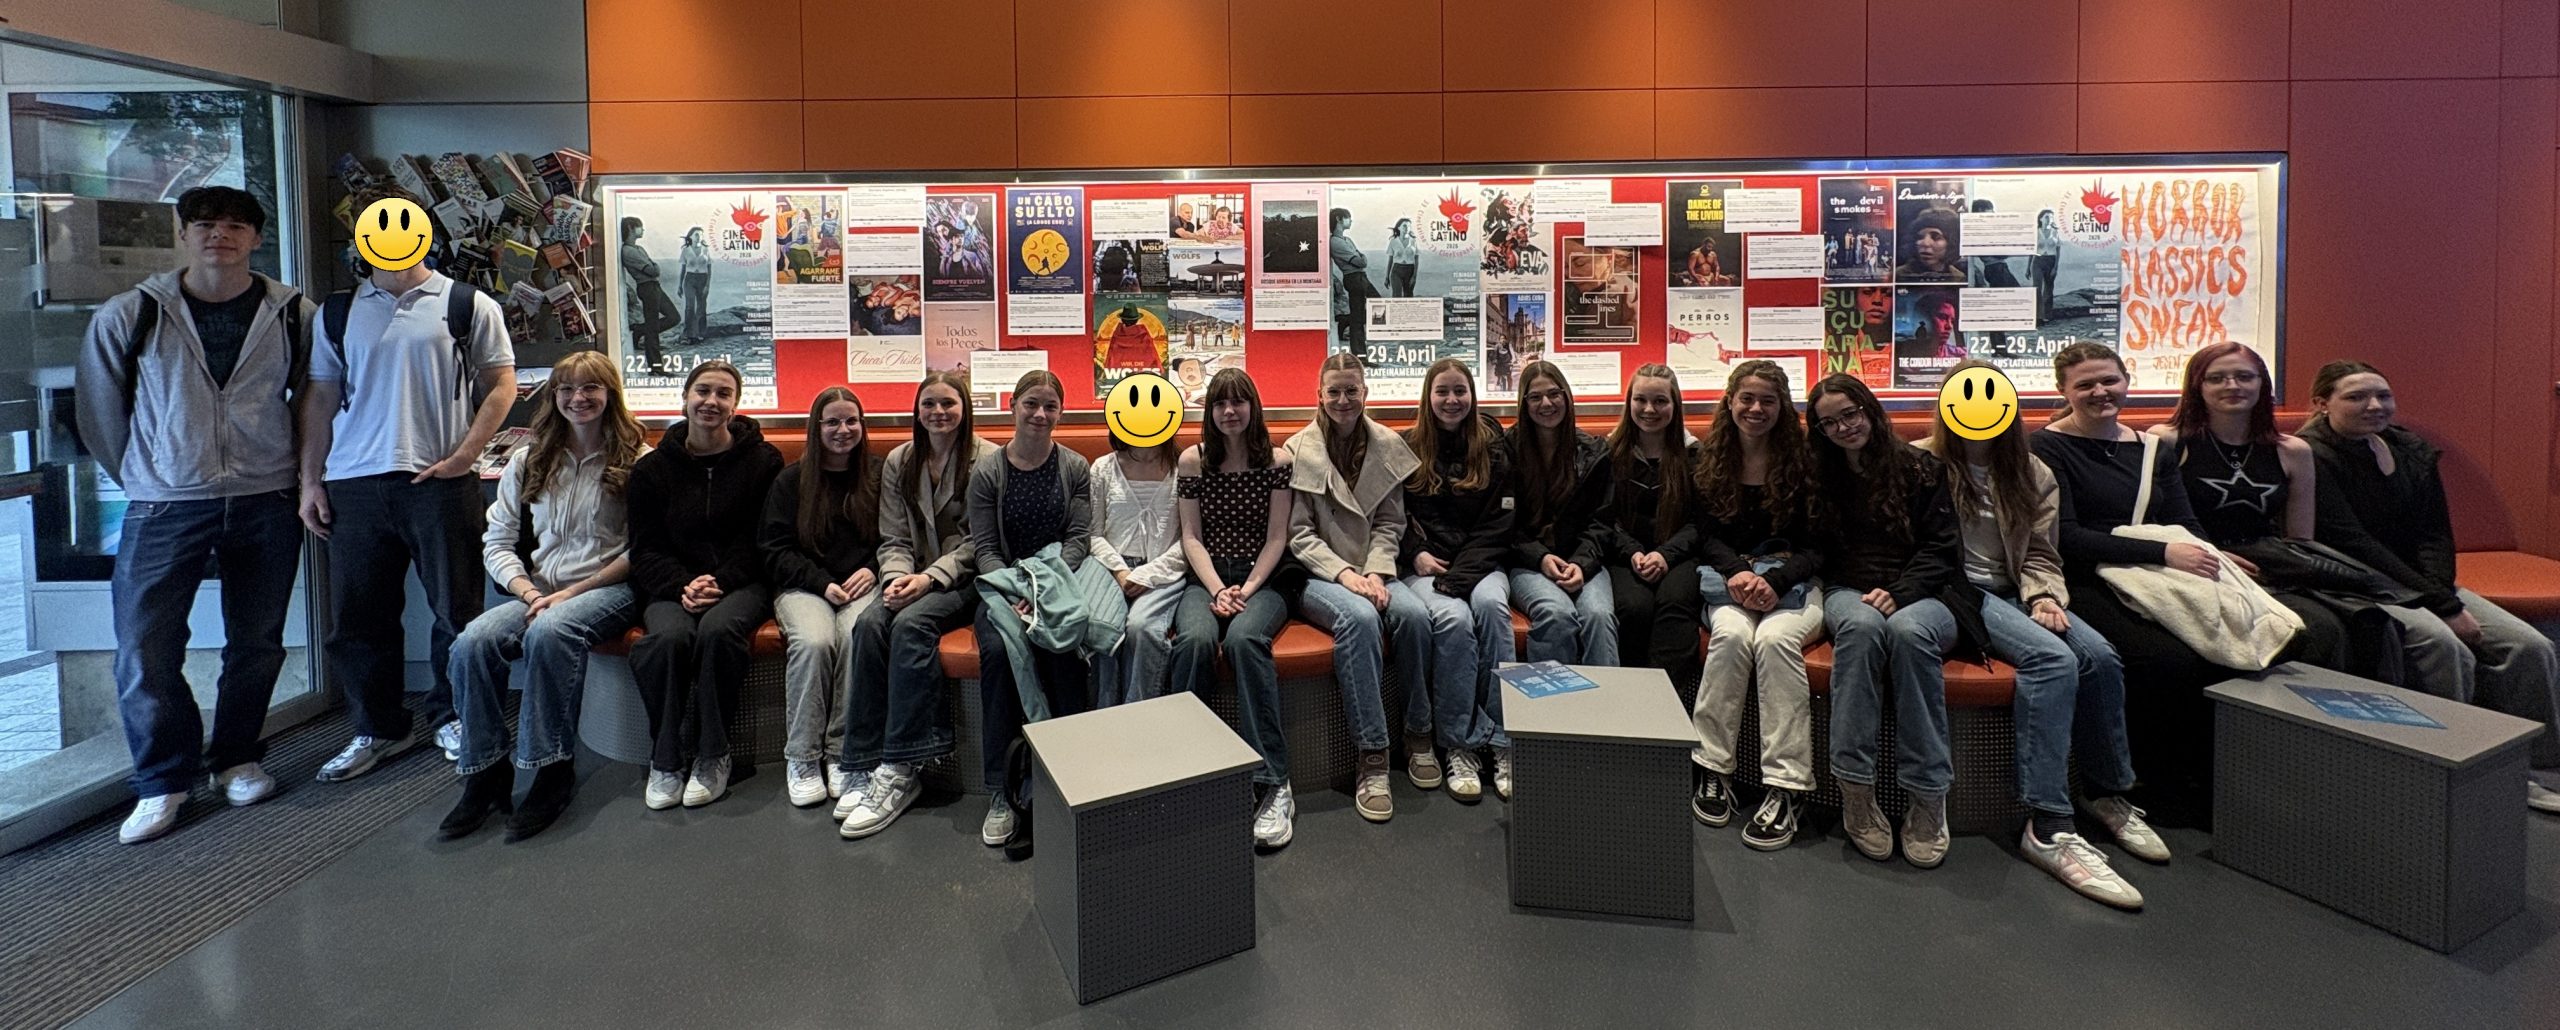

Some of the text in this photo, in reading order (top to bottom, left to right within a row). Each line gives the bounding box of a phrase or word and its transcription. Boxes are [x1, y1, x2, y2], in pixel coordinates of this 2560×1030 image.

[1017, 195, 1073, 206] UN CABO
[1687, 199, 1722, 210] DANCE OF
[1830, 196, 1884, 206] the devil
[1015, 206, 1075, 218] SUELTO
[1834, 205, 1872, 214] smokes
[2121, 179, 2246, 244] HORROR
[1686, 210, 1700, 221] THE
[2073, 212, 2094, 222] CINE
[1430, 220, 1452, 231] CINE
[2073, 222, 2110, 233] LATINO
[723, 229, 745, 240] CINE
[1430, 231, 1467, 242] LATINO
[723, 239, 760, 250] LATINO
[1520, 251, 1544, 267] EVA
[800, 267, 841, 275] AGARRAME
[811, 275, 841, 283] FUERTE
[1579, 295, 1620, 304] the dashed
[1823, 290, 1855, 309] SU
[1599, 304, 1616, 312] lines
[1830, 311, 1865, 334] ÇU
[2126, 299, 2228, 351] SNEAK
[944, 325, 977, 337] Todos
[936, 337, 984, 349] los Peces
[851, 349, 922, 367] Chicas Tristes
[1396, 344, 1436, 366] April
[1828, 355, 1862, 373] NA
[1899, 357, 1910, 367] THE
[1910, 357, 1932, 367] CONDOR
[2009, 358, 2055, 368] LATEINAMER
[626, 378, 649, 387] FILME
[649, 378, 665, 386] AUS
